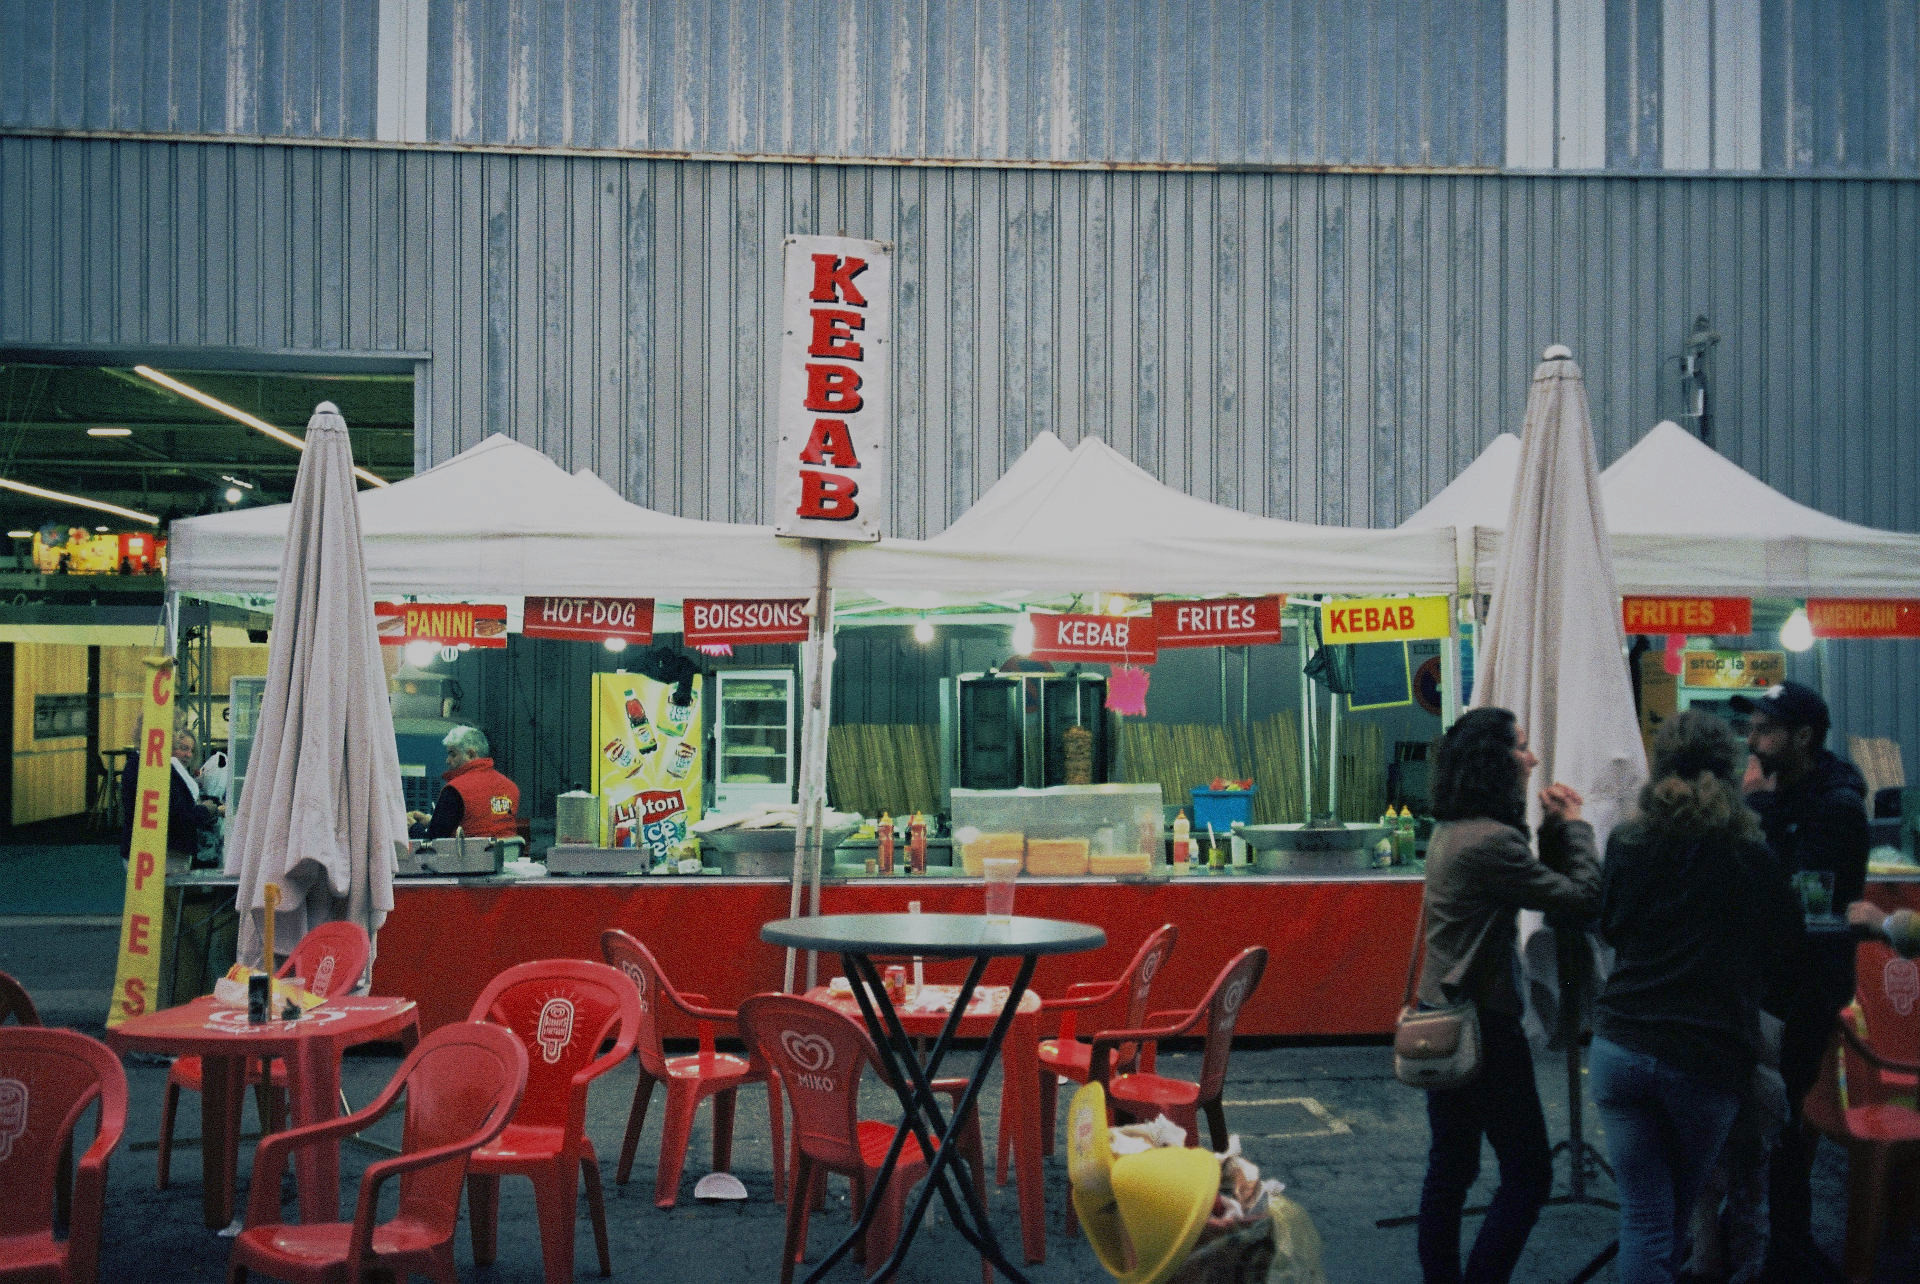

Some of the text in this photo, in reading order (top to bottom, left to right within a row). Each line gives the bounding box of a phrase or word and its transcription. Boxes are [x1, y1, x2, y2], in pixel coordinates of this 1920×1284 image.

[796, 253, 869, 521] KEBAB
[406, 610, 474, 638] PANINI
[542, 597, 636, 628] HOT-DOG
[693, 603, 803, 629] BOISSONS
[1177, 604, 1256, 631] FRITES
[1330, 605, 1415, 634] KEBAB
[1626, 601, 1715, 626] FRITES
[1057, 620, 1130, 647] KEBAB
[617, 796, 680, 822] Lipton
[122, 668, 171, 1017] CREPES
[797, 1072, 834, 1092] MIKO
